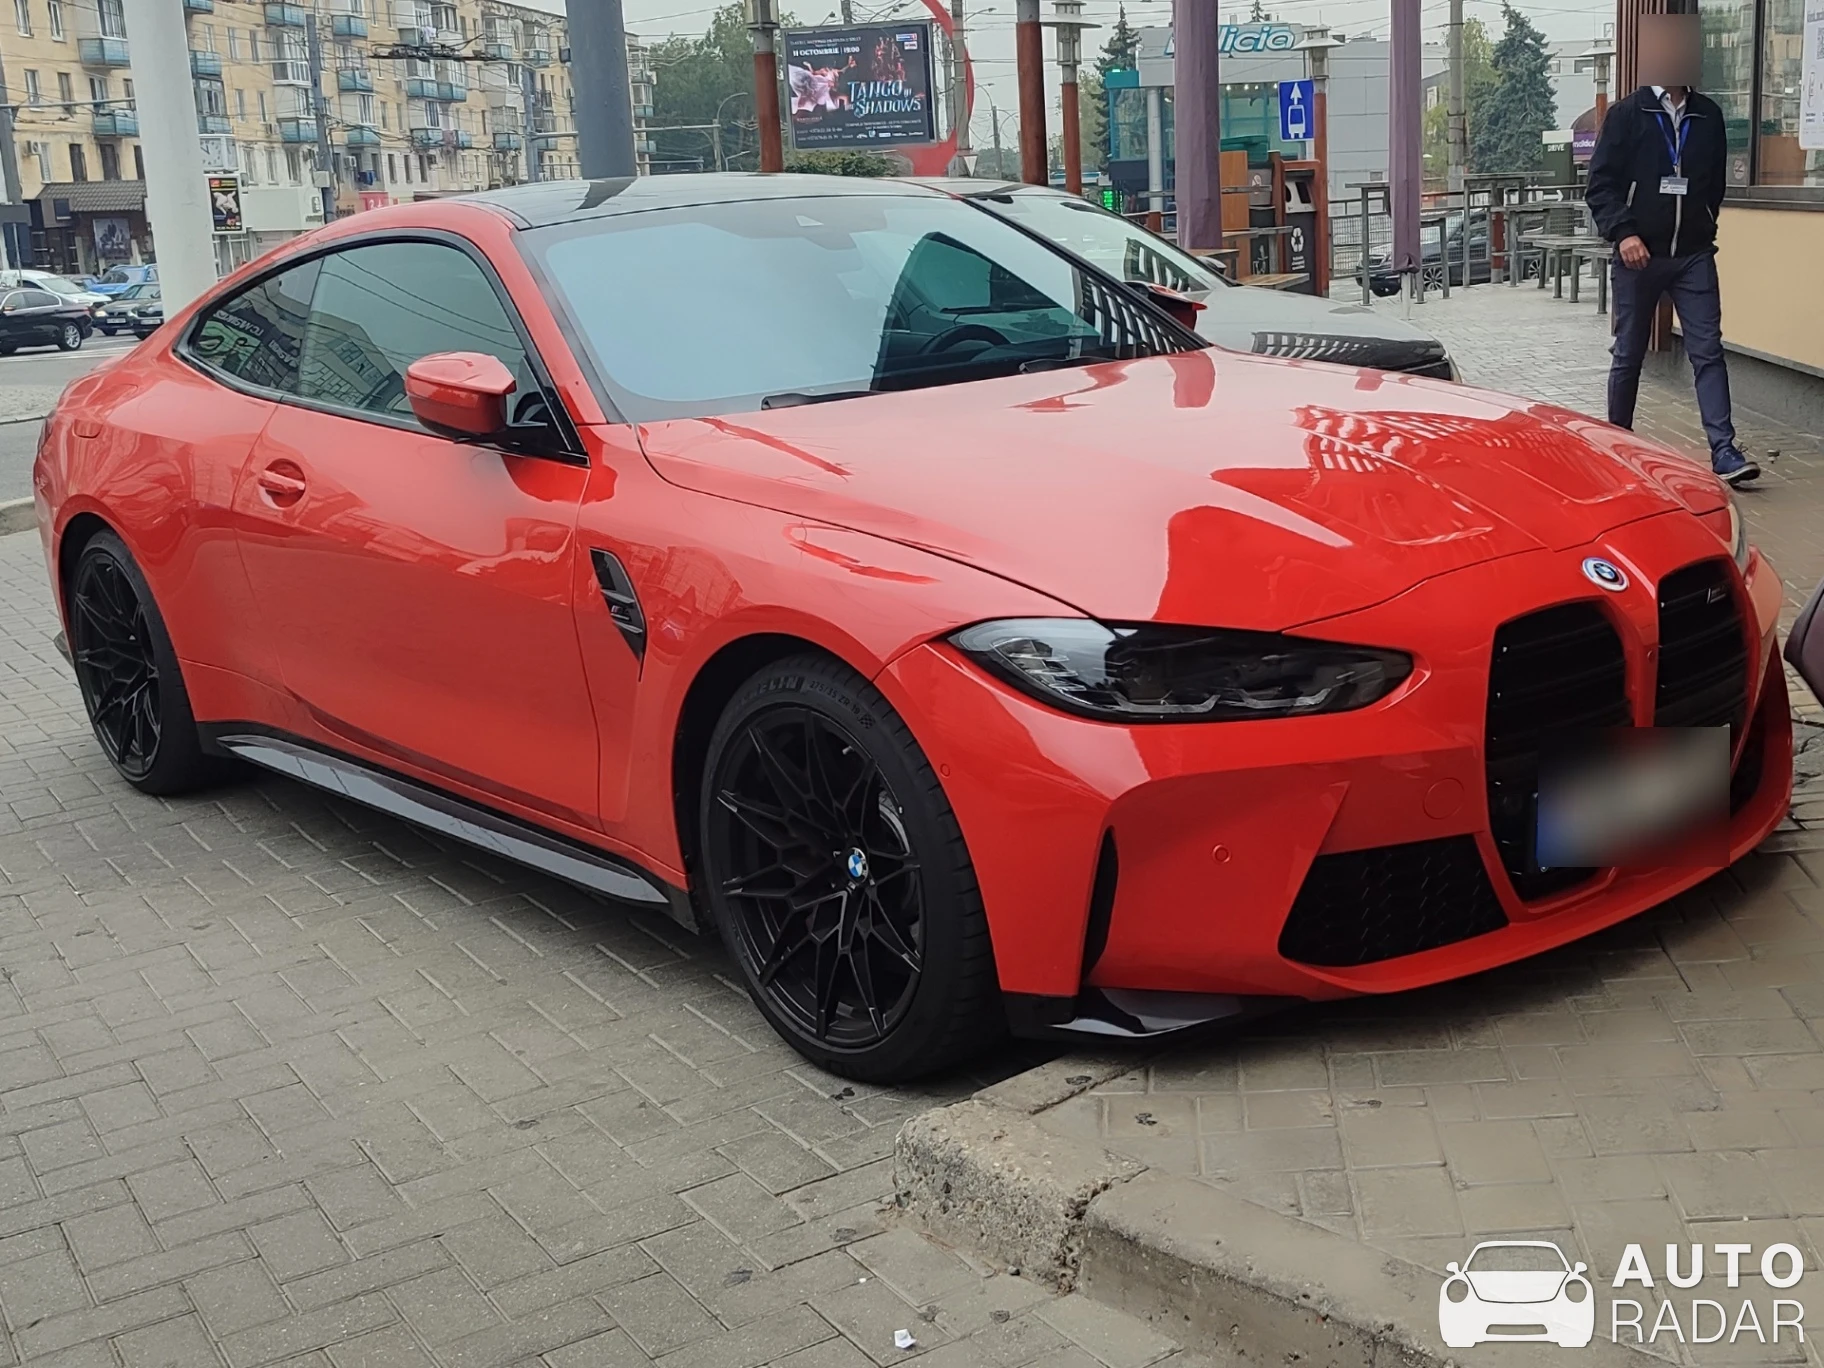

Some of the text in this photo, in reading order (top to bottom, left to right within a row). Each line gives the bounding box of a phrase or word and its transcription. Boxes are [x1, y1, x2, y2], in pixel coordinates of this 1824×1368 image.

[847, 80, 903, 102] TANGO
[854, 98, 921, 119] SHADOWS
[1547, 144, 1564, 152] DRIVE
